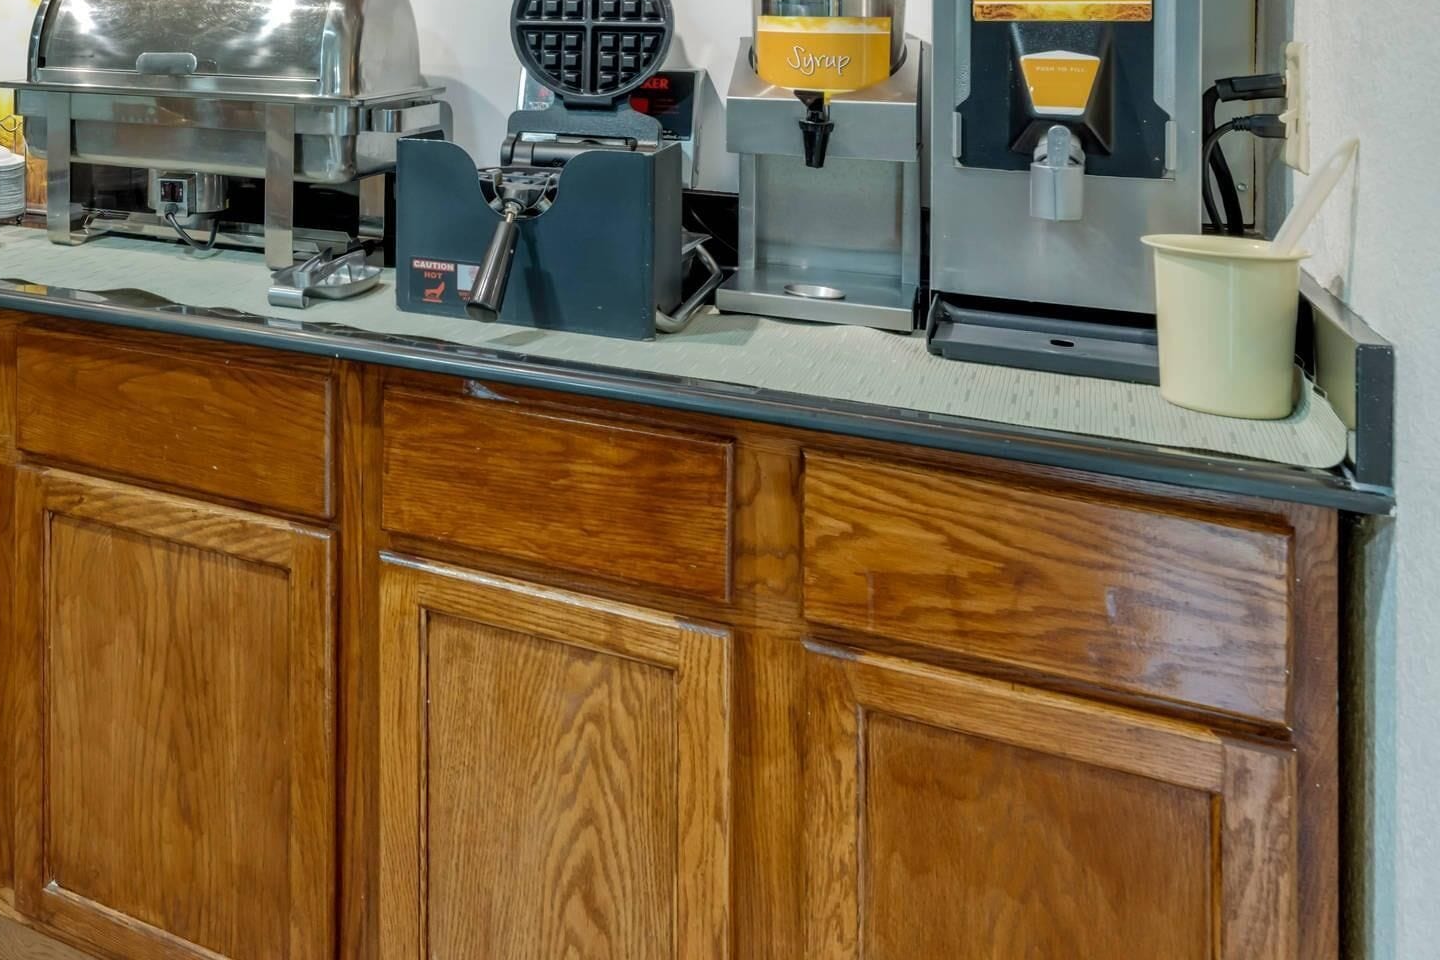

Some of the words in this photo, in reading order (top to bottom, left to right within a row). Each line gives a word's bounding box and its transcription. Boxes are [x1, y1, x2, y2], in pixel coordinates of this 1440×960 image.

[787, 45, 852, 76] Syrup
[640, 78, 669, 89] KER
[413, 260, 455, 273] CAUTION
[424, 271, 443, 280] HOT
